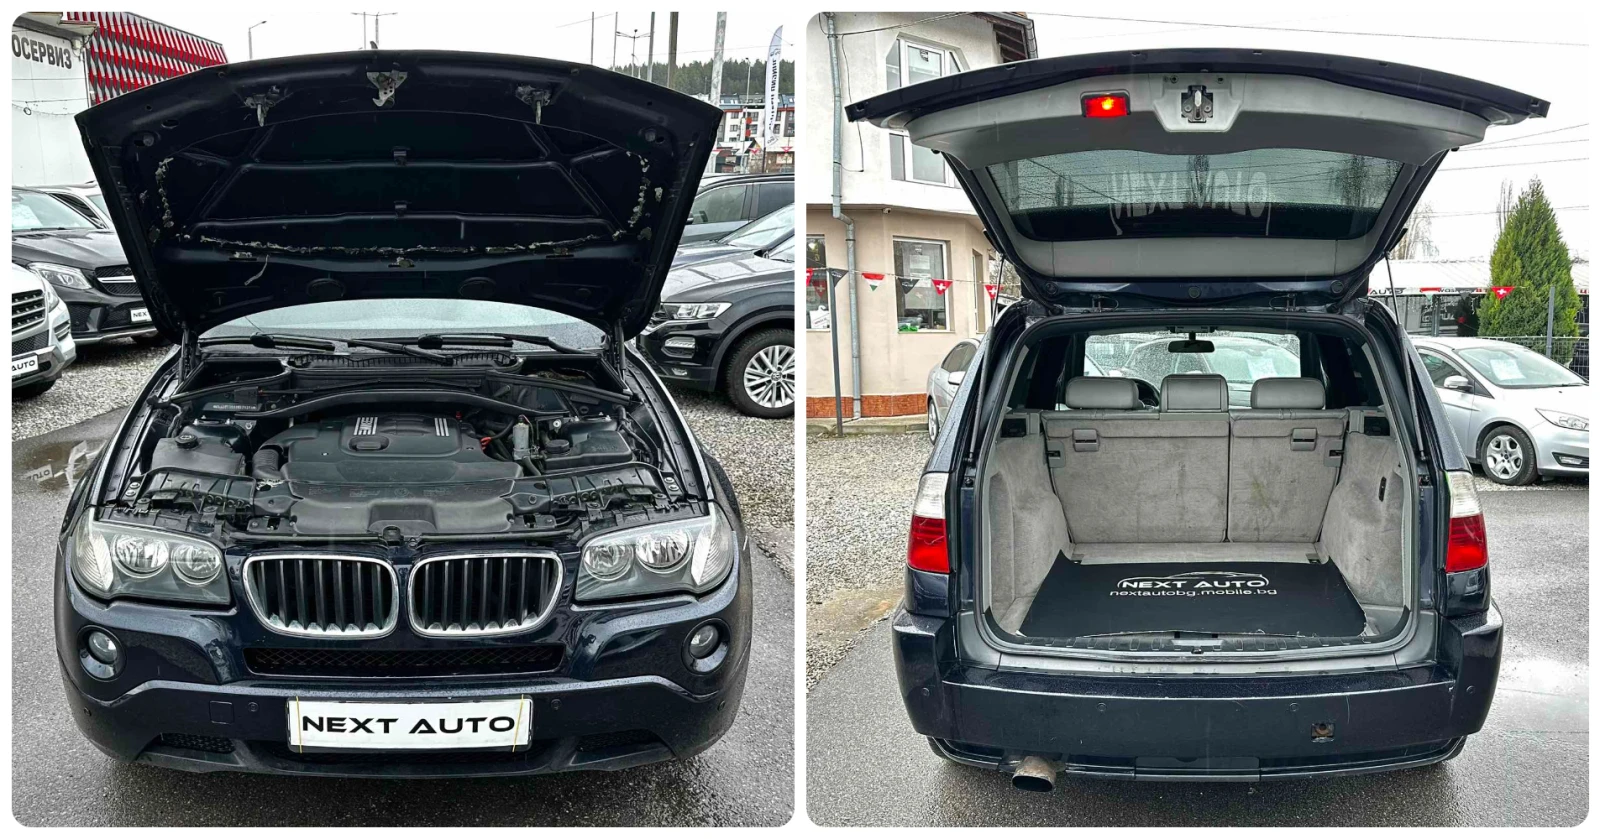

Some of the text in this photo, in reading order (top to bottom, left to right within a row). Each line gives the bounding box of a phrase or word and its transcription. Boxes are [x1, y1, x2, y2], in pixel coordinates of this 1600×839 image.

[12, 34, 72, 69] ОСЕРВИЗ
[1110, 588, 1278, 597] nextautobg.mobile.bg
[303, 716, 515, 734] NEXT AUTO
